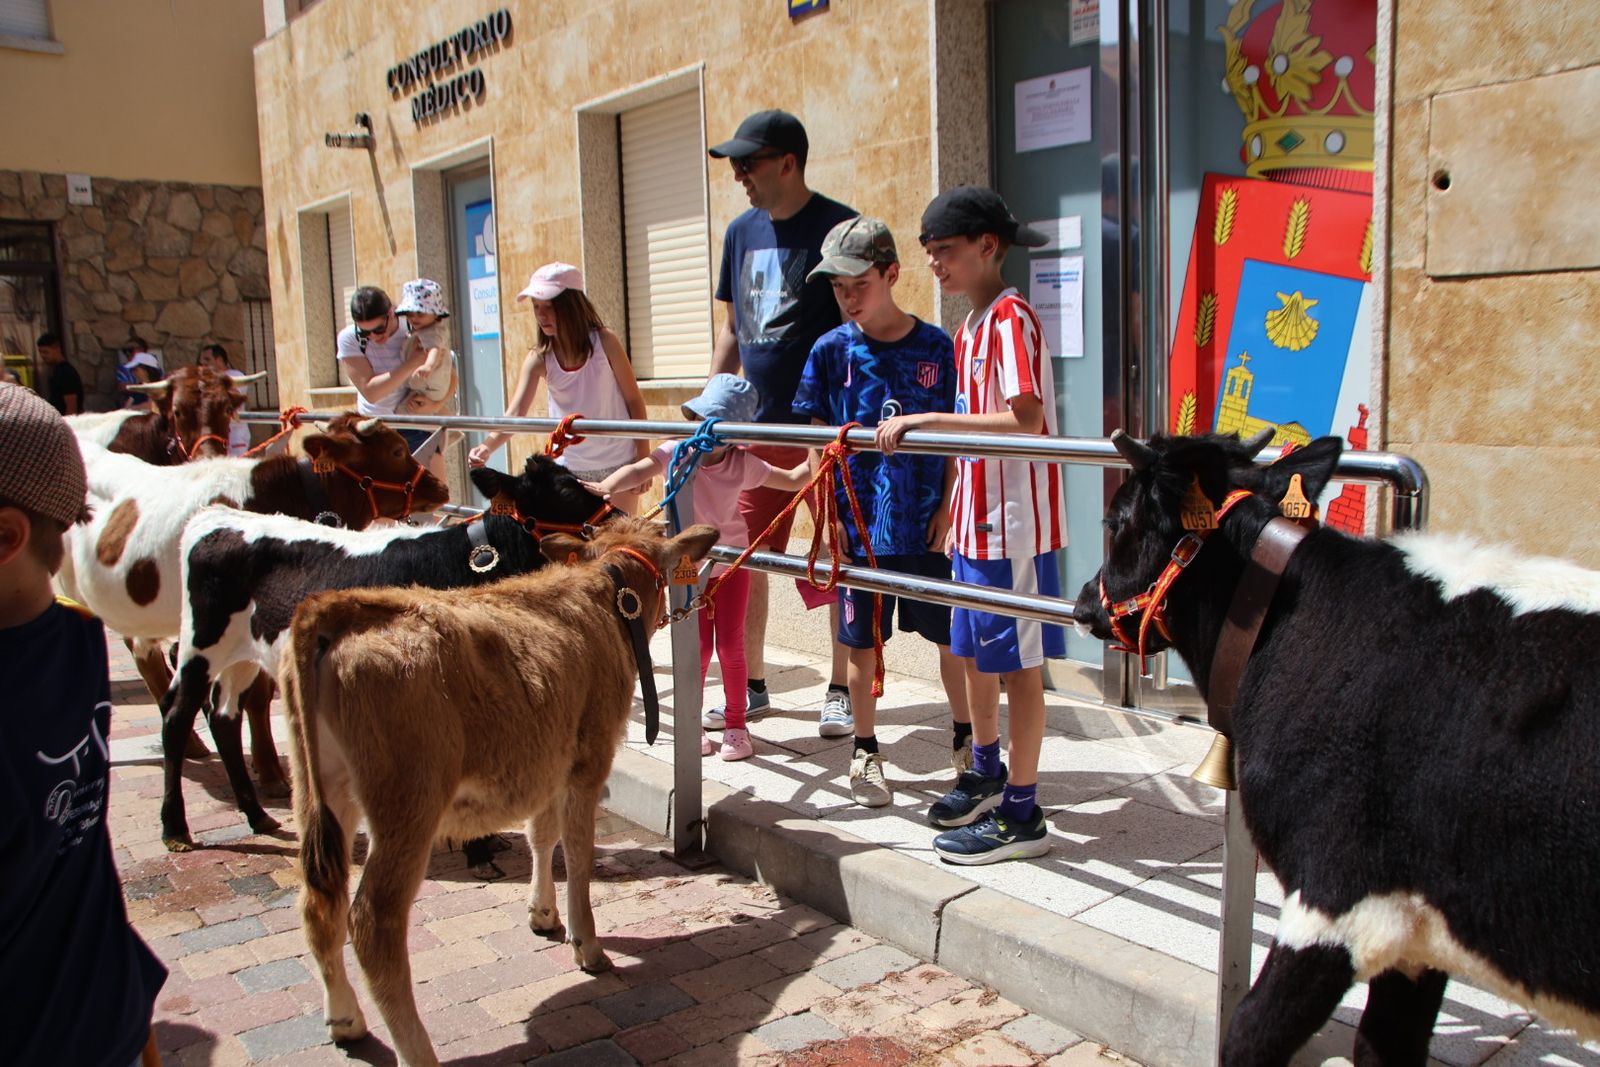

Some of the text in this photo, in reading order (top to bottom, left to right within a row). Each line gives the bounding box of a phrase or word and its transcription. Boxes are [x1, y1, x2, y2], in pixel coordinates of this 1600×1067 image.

[386, 9, 513, 93] CONSULTORIO
[412, 68, 485, 121] MÉDICO
[1183, 511, 1213, 528] 1057
[674, 570, 697, 579] 2305
